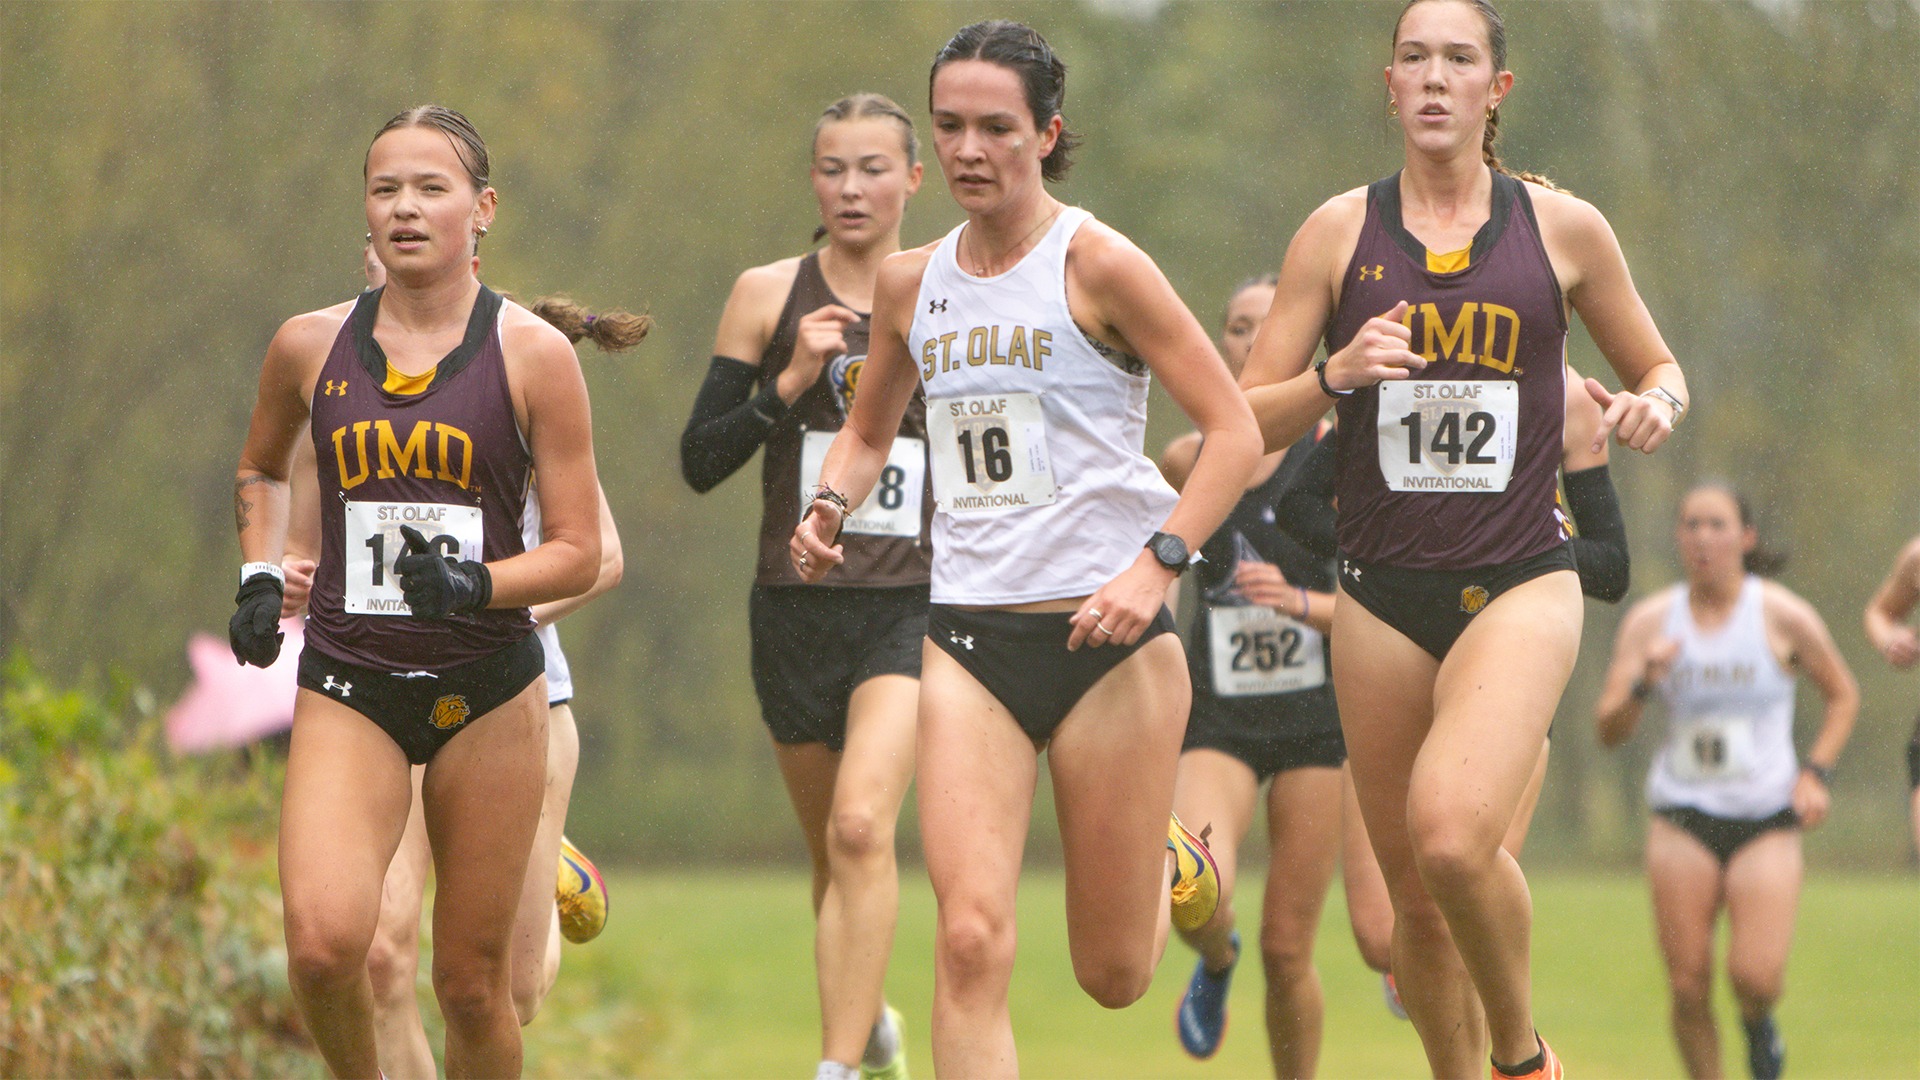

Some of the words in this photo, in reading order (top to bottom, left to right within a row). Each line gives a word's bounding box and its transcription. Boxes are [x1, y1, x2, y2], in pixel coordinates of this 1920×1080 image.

[922, 331, 960, 382] ST.
[967, 325, 1053, 371] OLAF
[1413, 384, 1436, 399] ST.
[1438, 384, 1483, 399] OLAF
[949, 401, 968, 417] ST.
[969, 398, 1007, 416] OLAF
[1400, 411, 1497, 465] 142
[331, 420, 473, 490] UMD
[957, 427, 1013, 483] 16
[1402, 476, 1492, 489] INVITATIONAL
[953, 493, 1030, 509] INVITATIONAL
[377, 505, 400, 521] ST.
[402, 505, 447, 522] OLAF
[845, 519, 896, 531] TATIONAL
[366, 599, 413, 612] INVITA
[1230, 627, 1306, 672] 252
